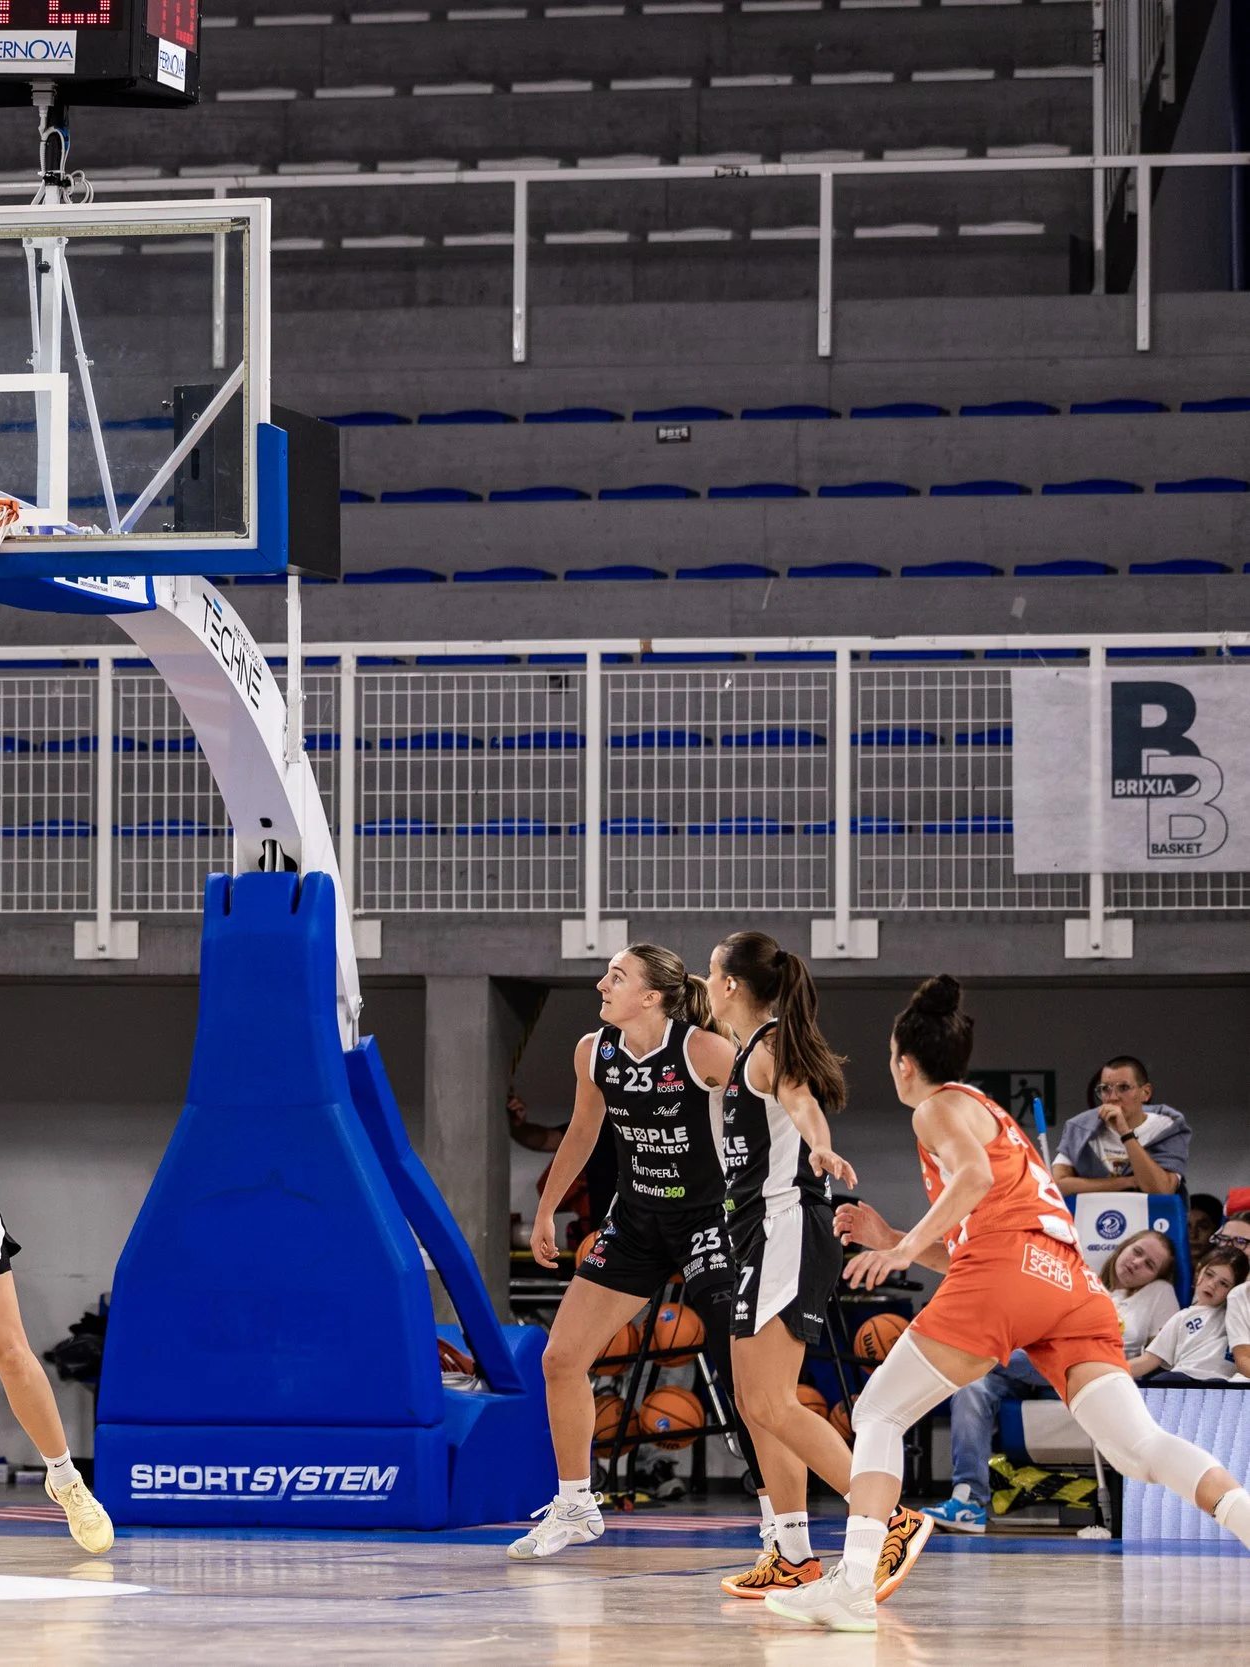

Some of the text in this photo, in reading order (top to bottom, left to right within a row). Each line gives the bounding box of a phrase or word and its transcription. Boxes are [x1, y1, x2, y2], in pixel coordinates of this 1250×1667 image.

[1114, 778, 1177, 796] BRIXIA
[1151, 843, 1202, 854] BASKET
[623, 1066, 653, 1092] 23
[656, 1084, 685, 1093] ROSETO
[636, 1143, 690, 1154] STRATEGY
[691, 1227, 721, 1256] 23
[1029, 1258, 1072, 1287] SCHIO
[1185, 1317, 1203, 1334] 32
[131, 1464, 400, 1498] SPORTSYSTEM
